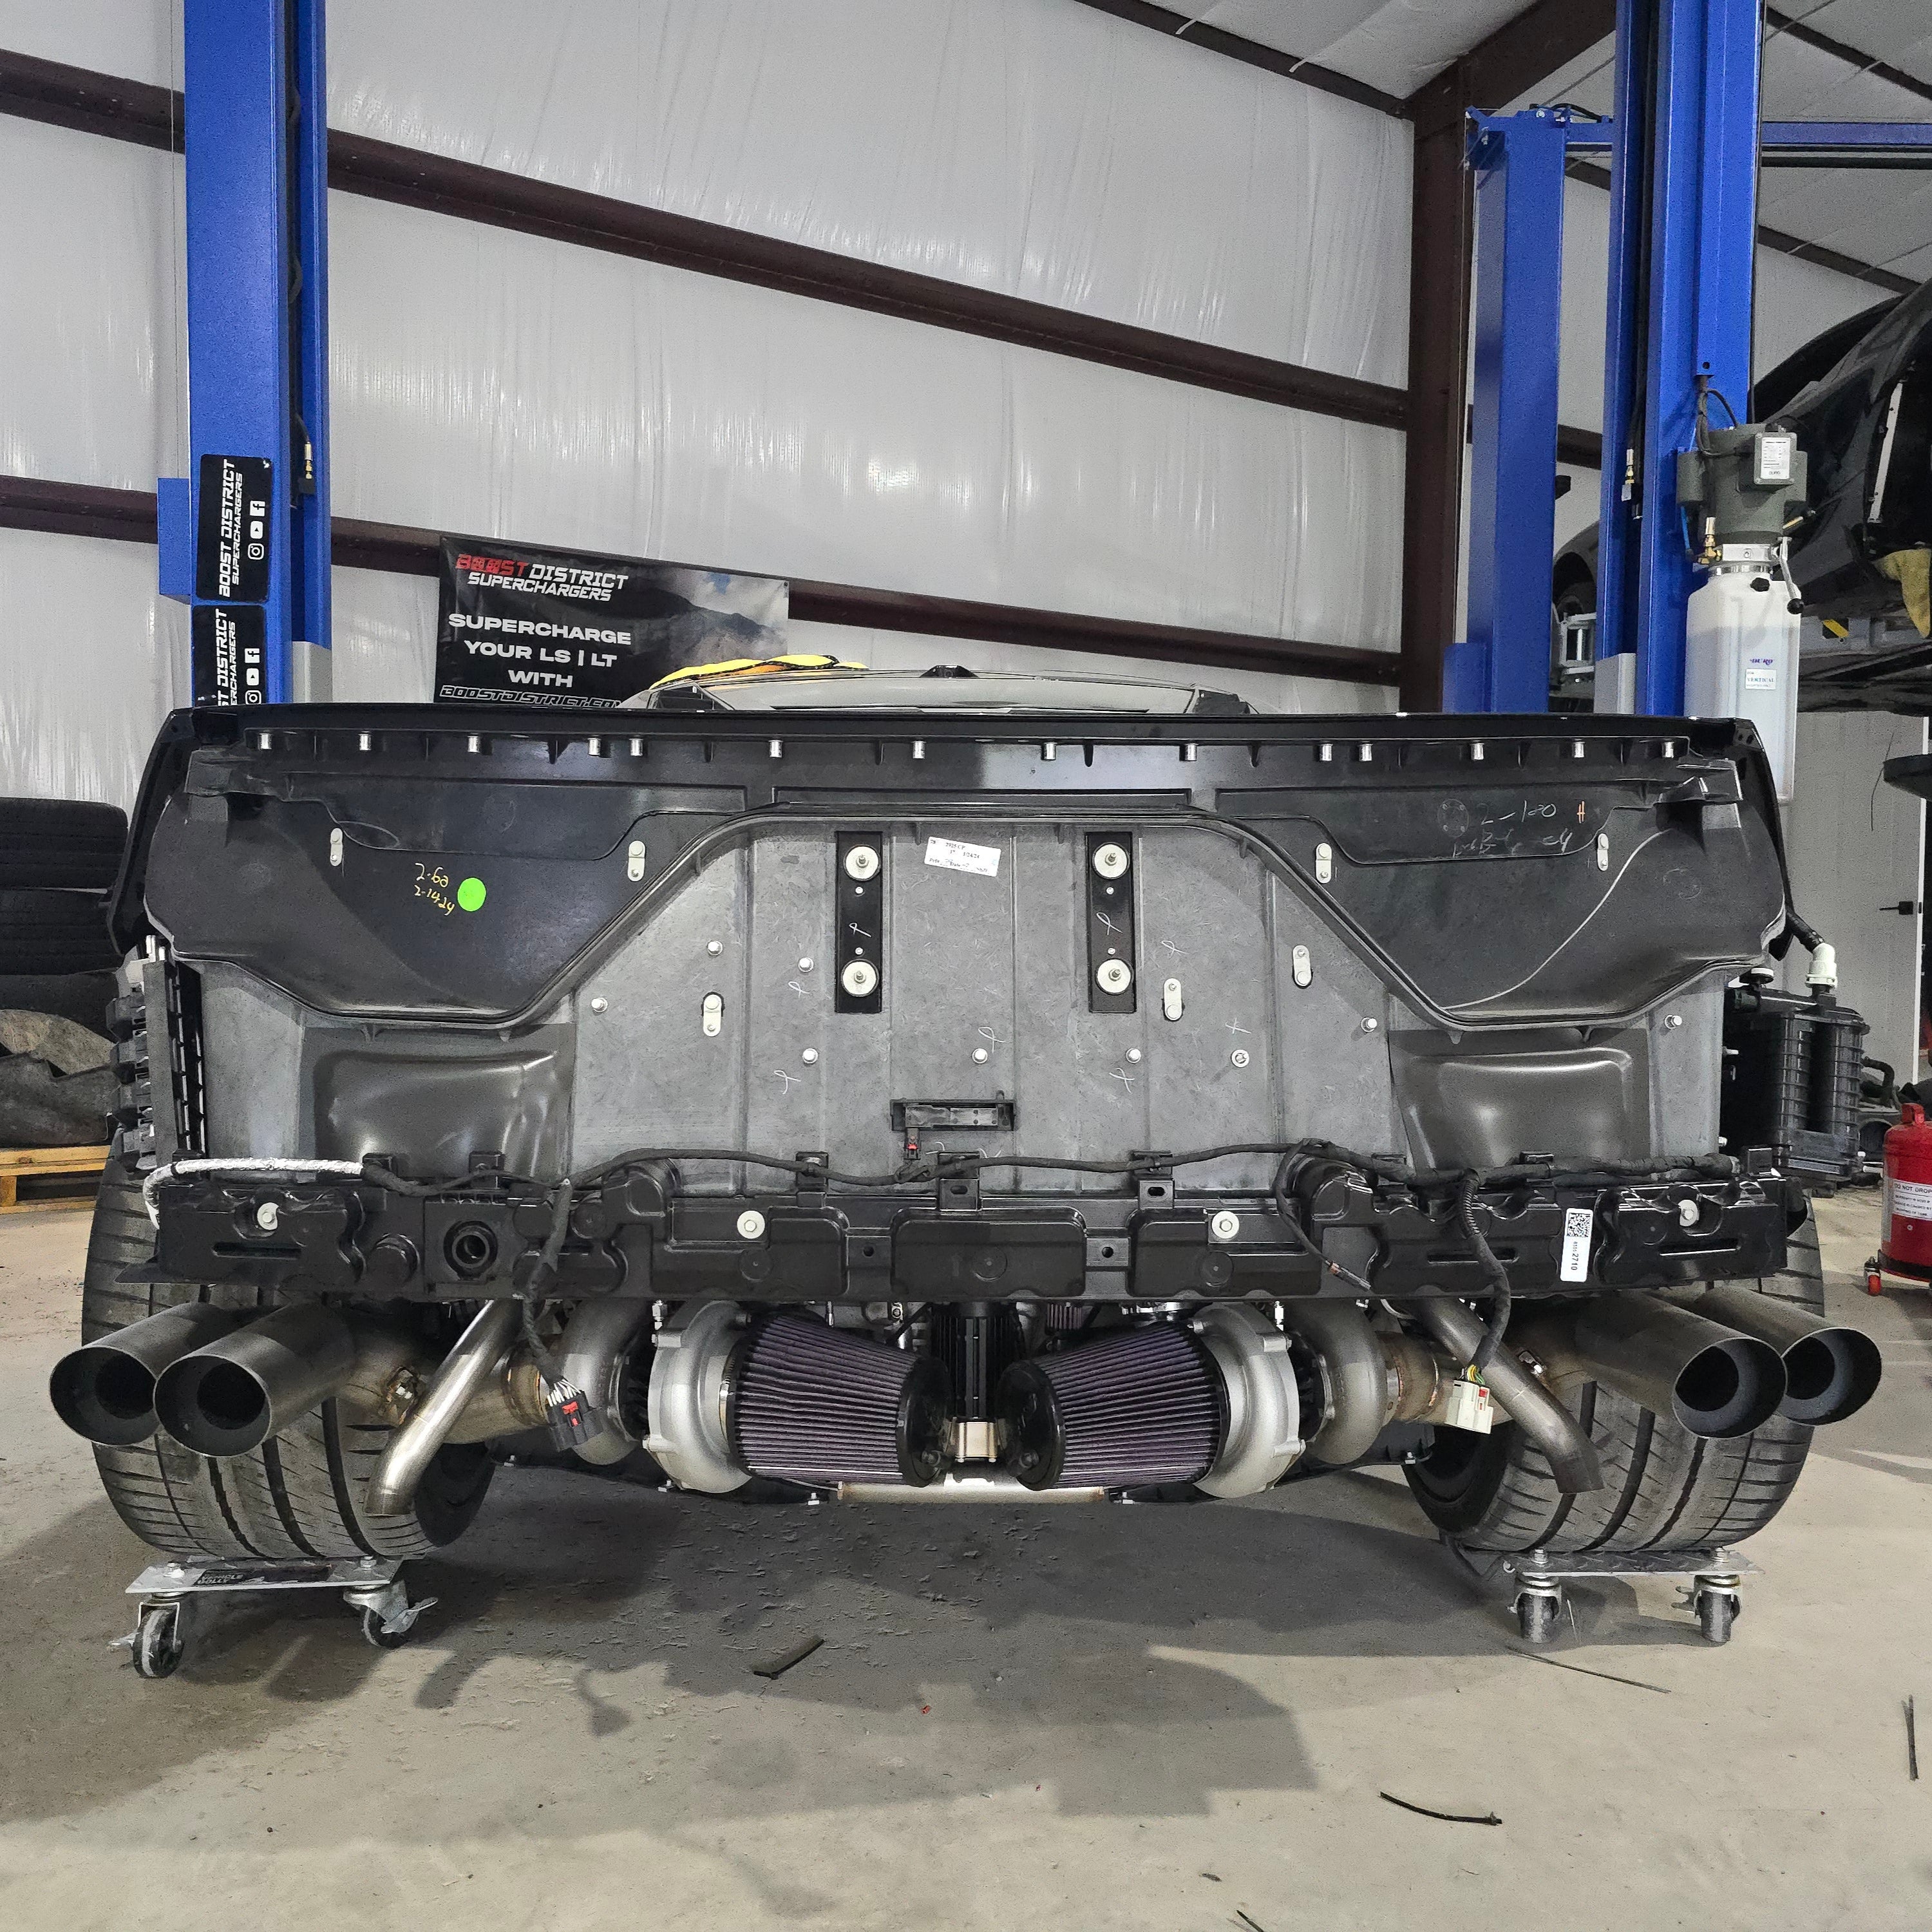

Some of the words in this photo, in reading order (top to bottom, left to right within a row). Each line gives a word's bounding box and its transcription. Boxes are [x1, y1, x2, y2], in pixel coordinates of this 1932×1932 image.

[220, 459, 235, 538] DISTRICT
[232, 473, 243, 585] SUPERCHARGERS
[218, 544, 232, 598] BOOST
[455, 553, 529, 577] BOOST
[529, 564, 629, 590] DISTRICT
[468, 572, 612, 601] SUPERCHARGERS
[215, 608, 229, 688] DISTRICT
[448, 613, 632, 645] SUPERCHARGE
[229, 620, 238, 706] ERCHARGERS
[464, 639, 533, 660] YOUR
[540, 648, 571, 664] LS
[591, 652, 618, 668] LT
[507, 669, 573, 688] WITH
